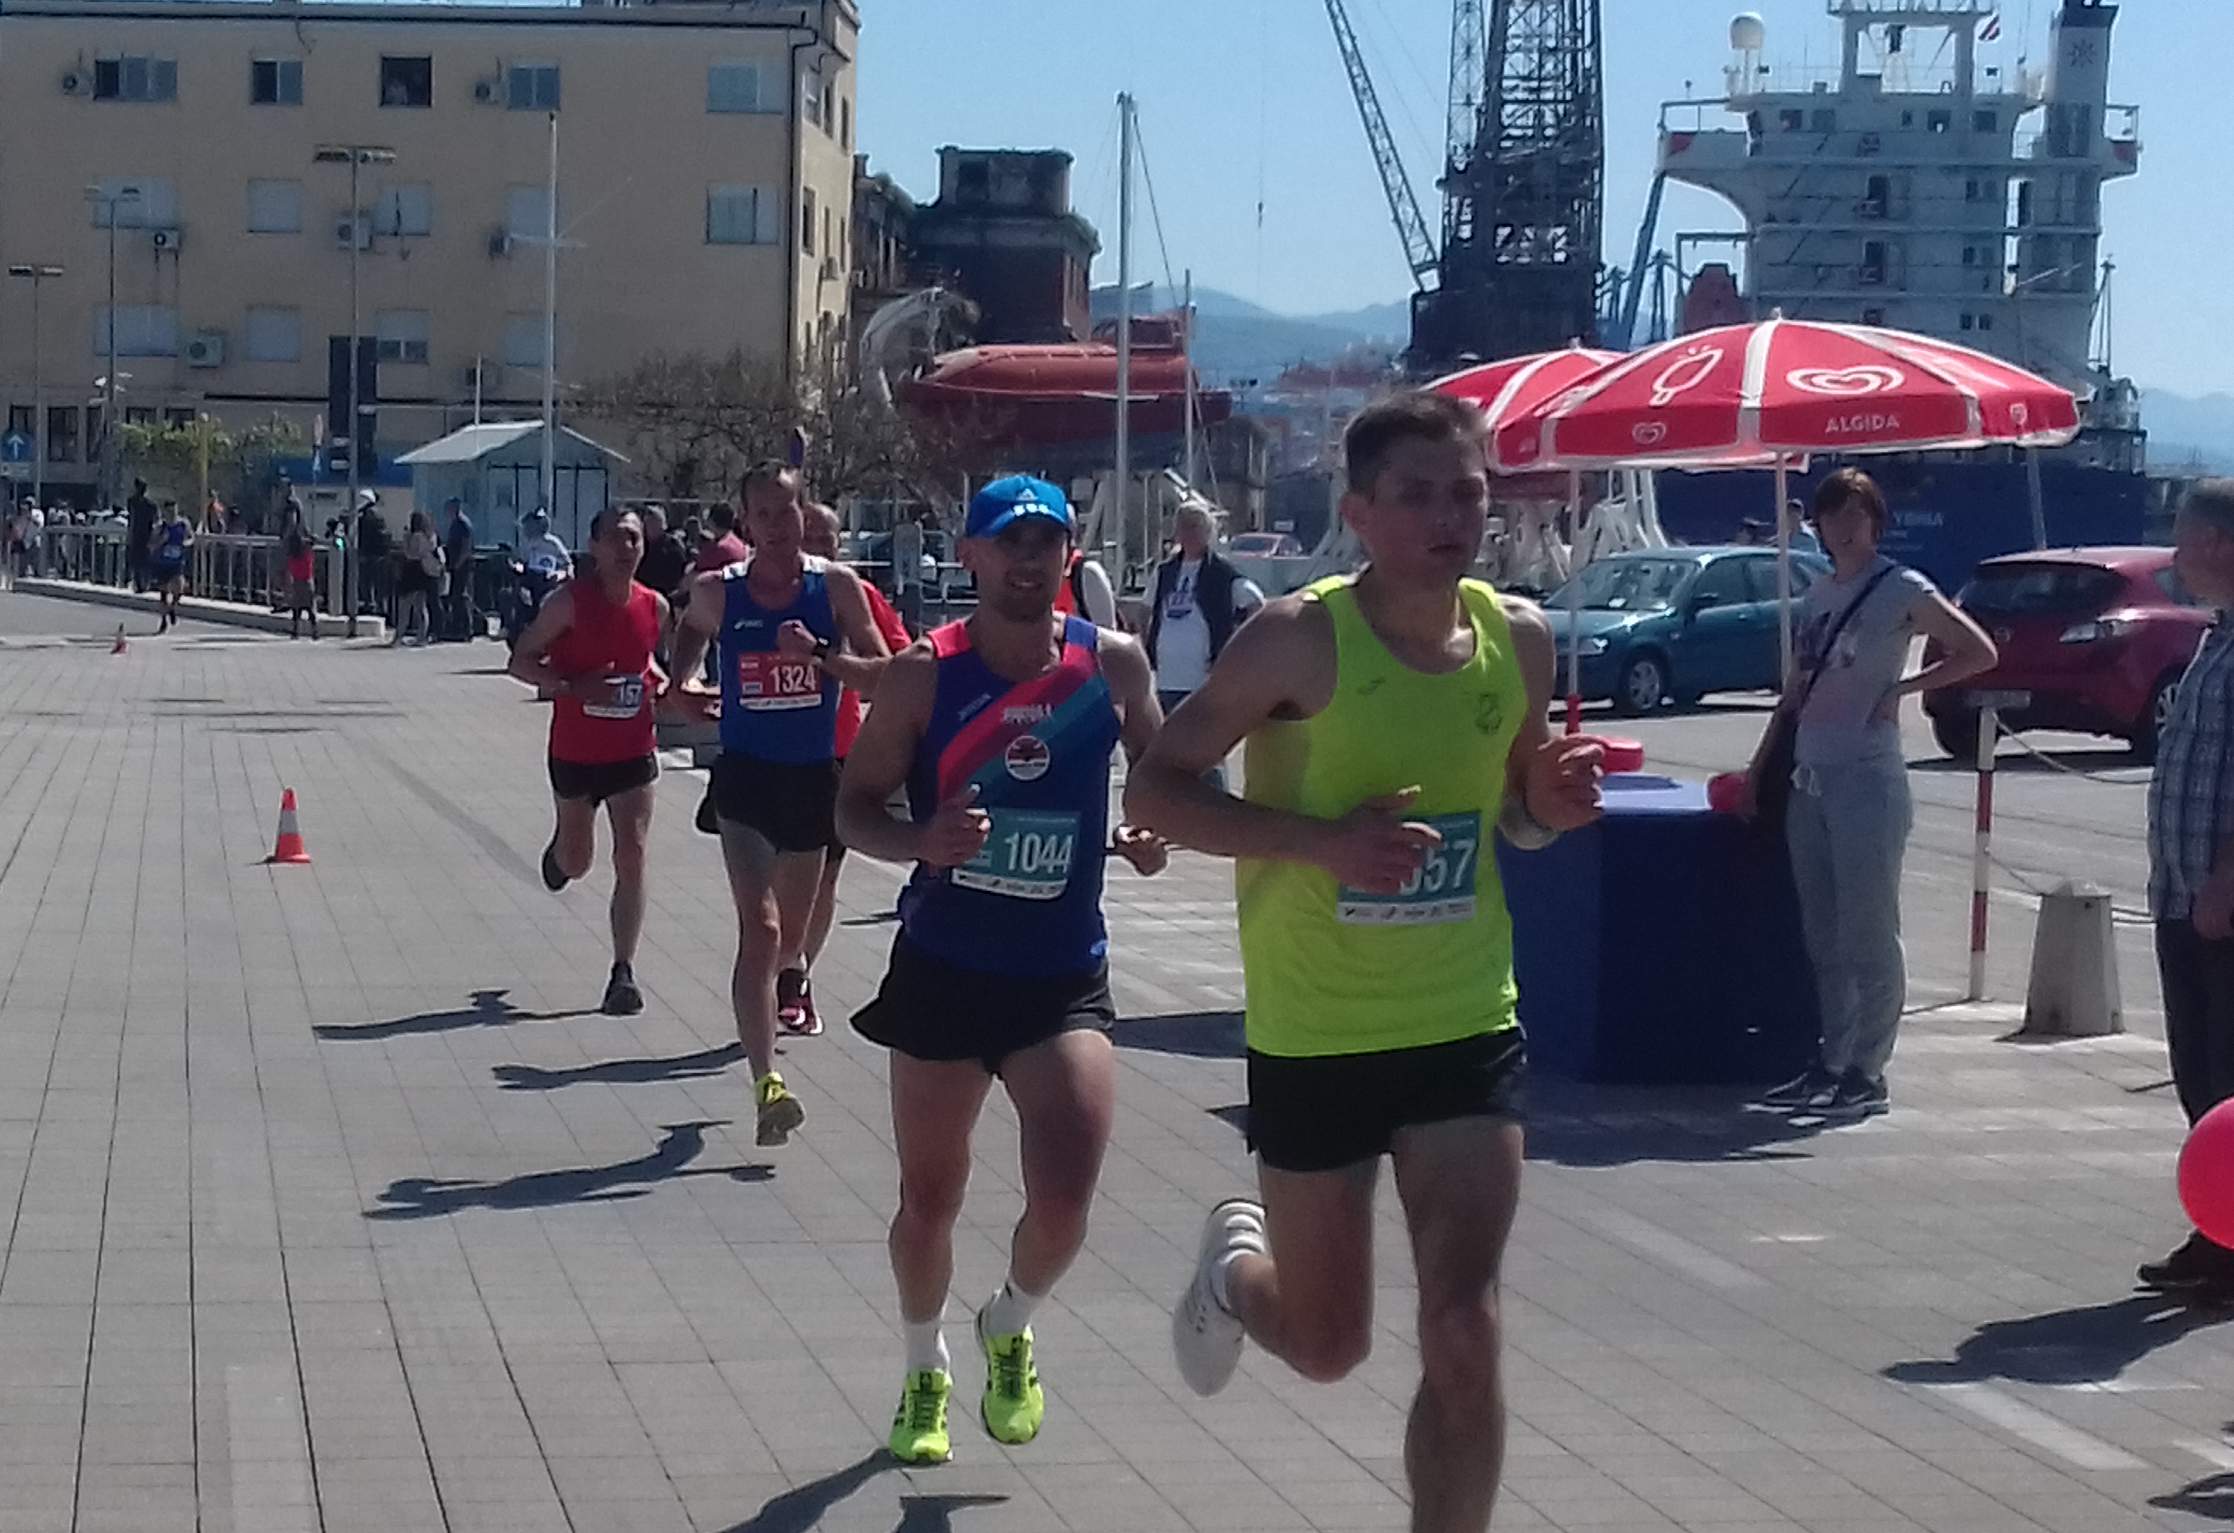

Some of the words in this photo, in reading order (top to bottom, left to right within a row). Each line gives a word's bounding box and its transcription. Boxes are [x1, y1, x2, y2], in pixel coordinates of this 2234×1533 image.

[1825, 414, 1900, 433] ALGIDA
[770, 664, 817, 693] 1324
[1004, 832, 1073, 874] 1044
